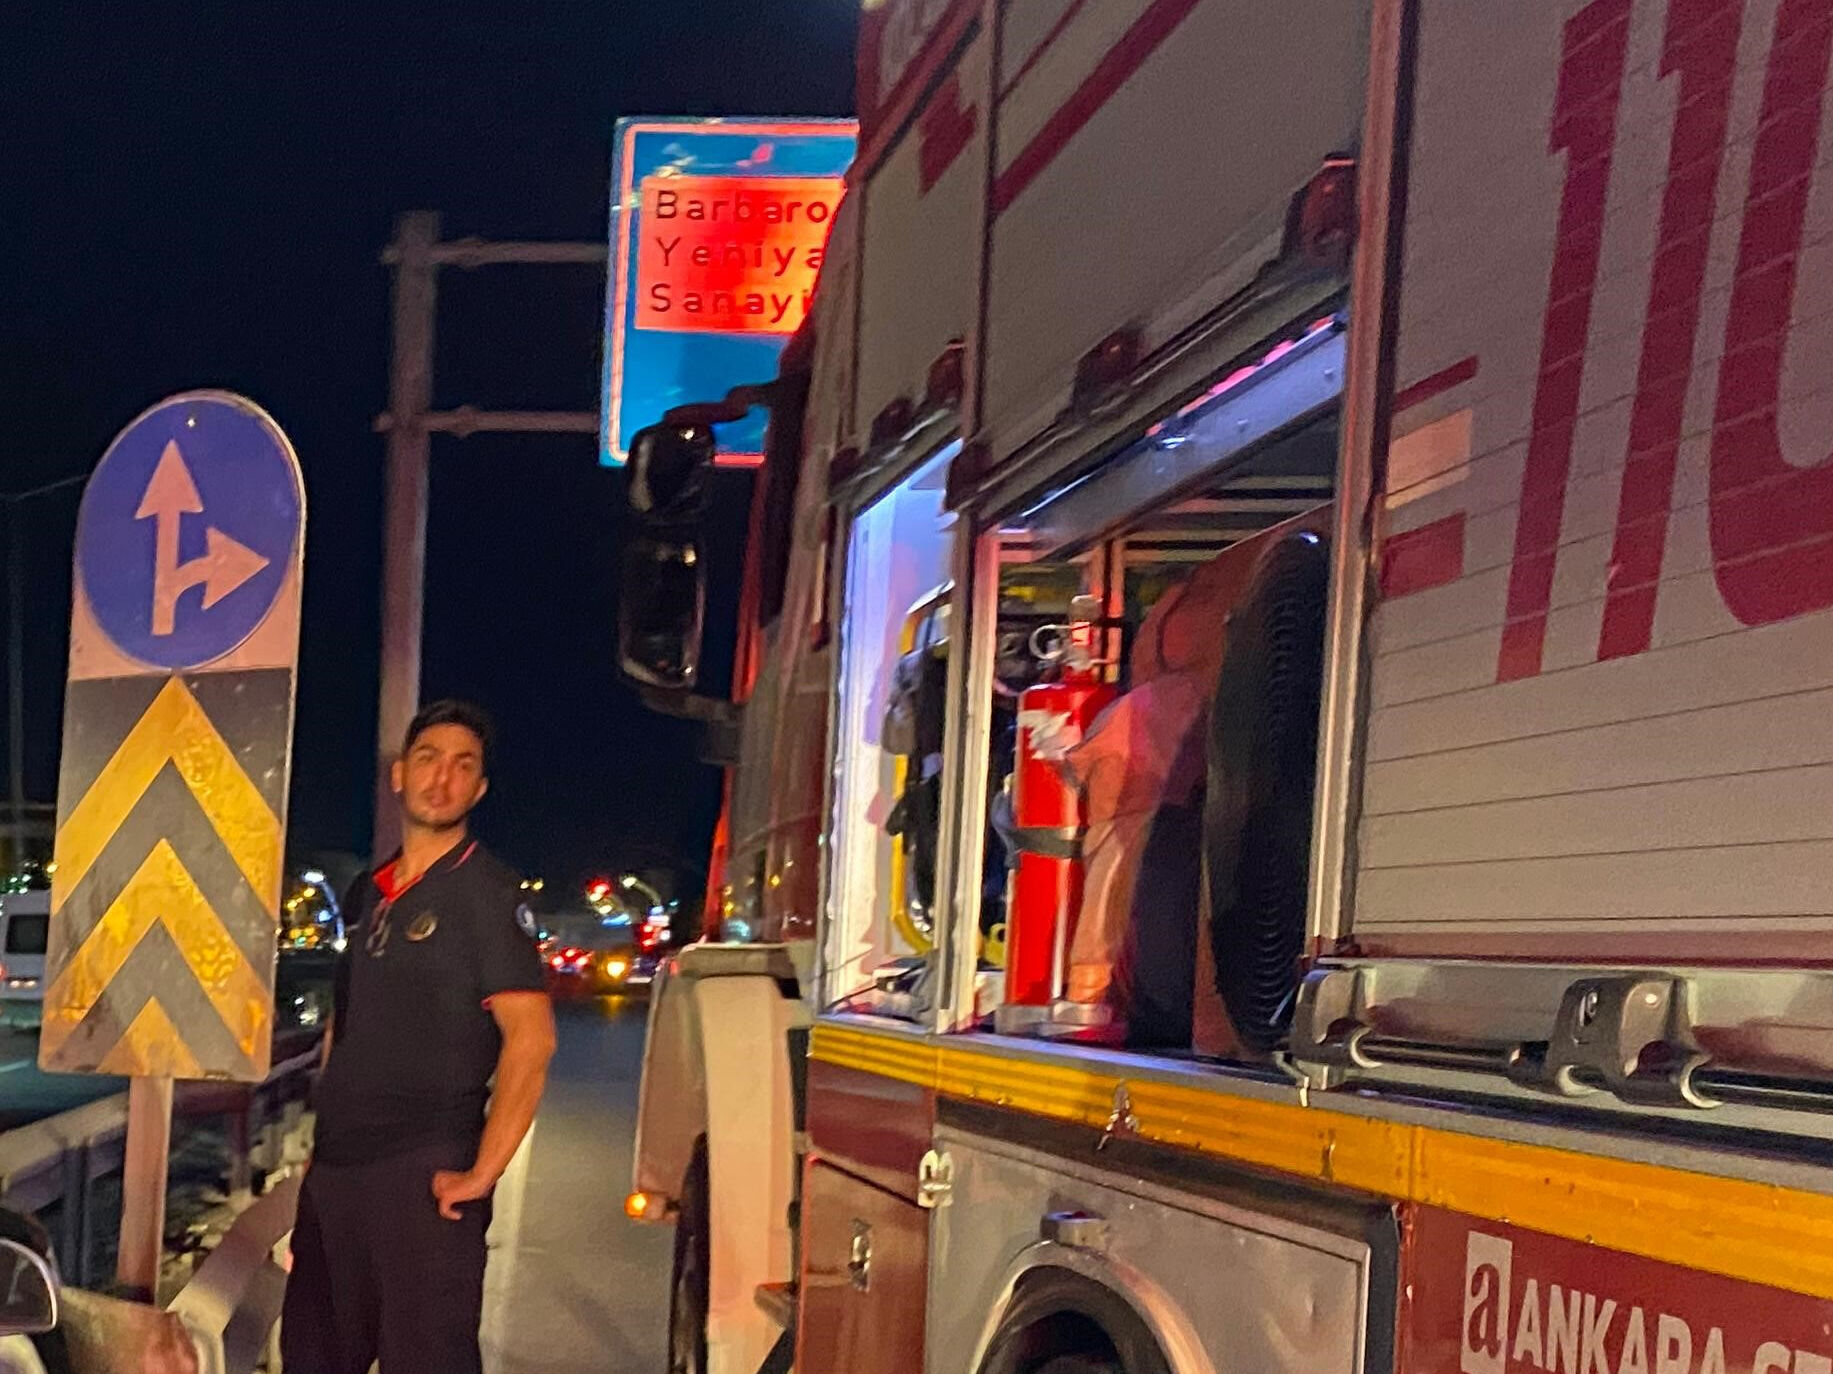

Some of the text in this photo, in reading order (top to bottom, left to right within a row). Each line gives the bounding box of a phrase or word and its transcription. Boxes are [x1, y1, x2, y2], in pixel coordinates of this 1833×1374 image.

[655, 189, 828, 225] Barbaro
[656, 237, 823, 277] Yeniya
[650, 283, 811, 324] Sanayi
